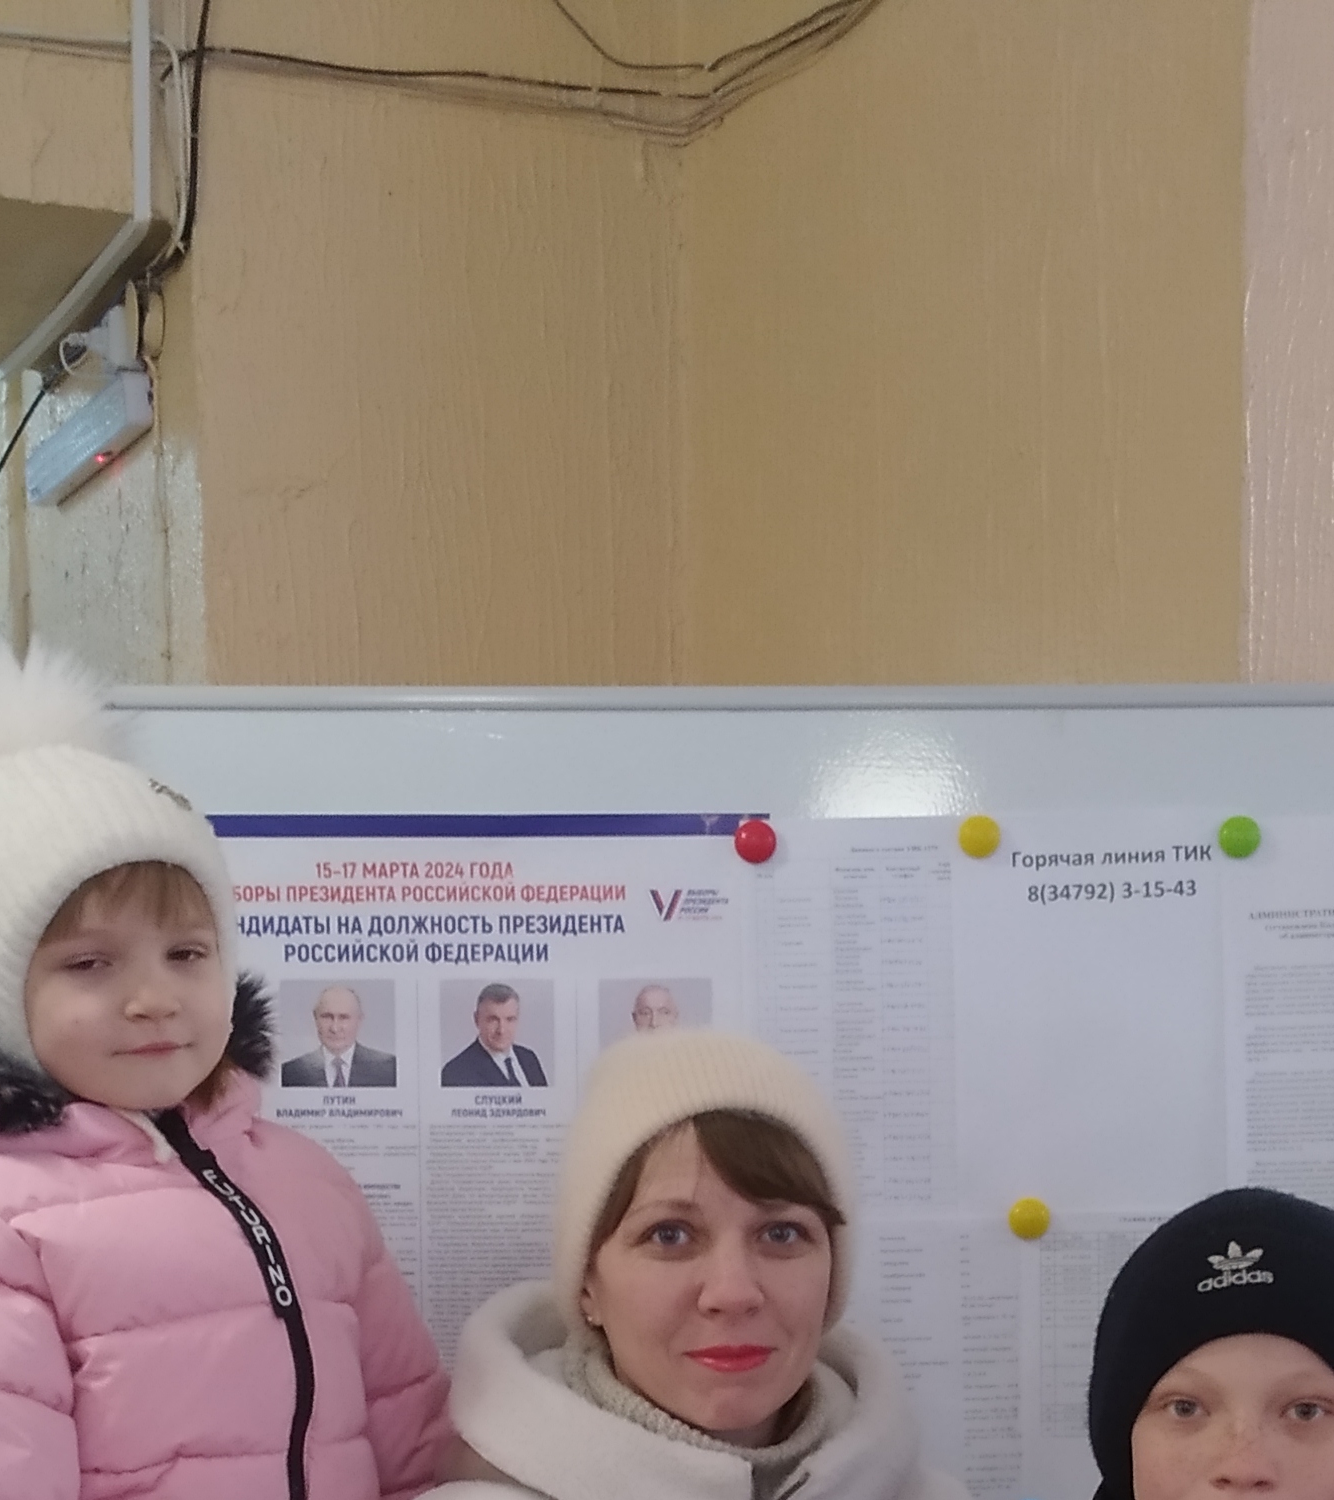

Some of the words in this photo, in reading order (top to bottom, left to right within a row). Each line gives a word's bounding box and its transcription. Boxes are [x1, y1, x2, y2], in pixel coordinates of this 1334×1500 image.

[1011, 850, 1095, 871] Горячая
[1101, 849, 1166, 865] линия
[1172, 844, 1212, 862] ТИК
[315, 861, 357, 879] 15-17
[362, 861, 419, 879] МАРТА
[424, 861, 465, 879] 2024
[469, 861, 514, 880] ГОДА
[232, 885, 281, 902] БОРЫ
[286, 885, 396, 905] ПРЕЗИДЕНТА
[401, 881, 516, 903] РОССИЙСКОЙ
[520, 883, 627, 904] ФЕДЕРАЦИИ
[1027, 881, 1115, 906] 8(34792)
[1122, 879, 1197, 899] 3-15-43
[237, 915, 331, 937] НДИДАТЫ
[337, 915, 363, 935] НА
[368, 914, 493, 937] ДОЛЖНОСТЬ
[499, 914, 626, 936] ПРЕЗИДЕНТА
[284, 939, 418, 963] РОССИЙСКОЙ
[424, 942, 549, 965] ФЕДЕРАЦИИ
[323, 1095, 356, 1106] ПУТИН
[474, 1093, 523, 1106] СЛУЦКИЙ
[202, 1168, 293, 1307] FUTURINO
[1196, 1269, 1275, 1293] adidas
